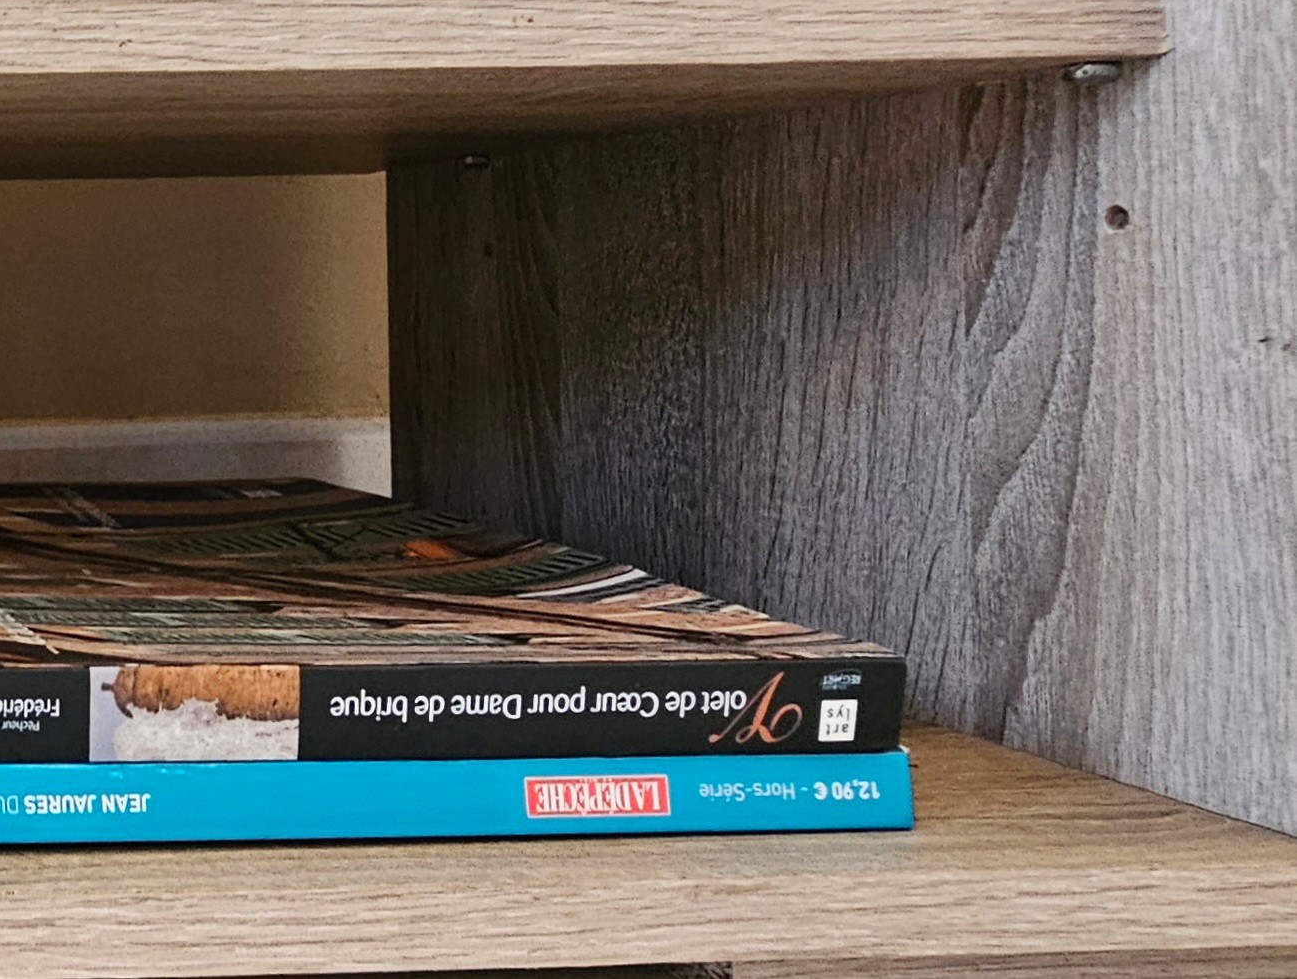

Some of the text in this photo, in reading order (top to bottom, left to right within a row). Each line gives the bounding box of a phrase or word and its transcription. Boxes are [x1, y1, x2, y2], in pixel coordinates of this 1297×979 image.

[329, 688, 408, 724] brique
[414, 694, 445, 723] de
[450, 693, 522, 720] Dame
[526, 685, 586, 714] pour
[590, 690, 659, 718] Cœur
[664, 689, 696, 719] de
[826, 723, 851, 737] art
[698, 781, 796, 802] Hors-Série
[813, 781, 828, 800] €
[831, 780, 882, 801] 12,90
[25, 794, 96, 814] JAURES
[101, 793, 151, 813] JEAN
